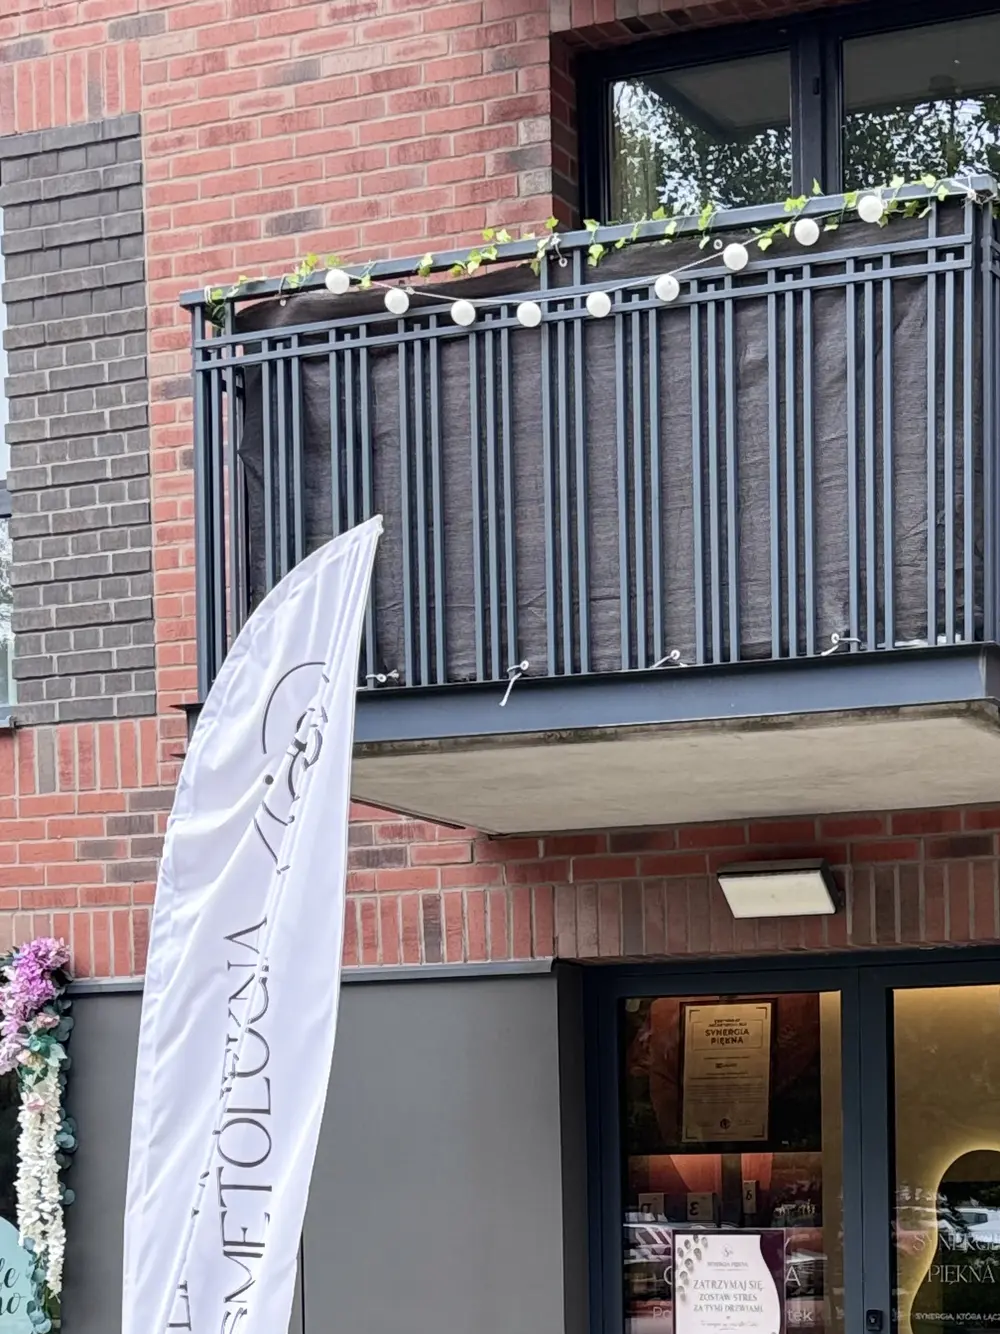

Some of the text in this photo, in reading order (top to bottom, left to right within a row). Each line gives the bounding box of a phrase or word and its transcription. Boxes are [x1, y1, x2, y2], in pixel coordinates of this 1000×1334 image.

[705, 1028, 749, 1037] SYNERGIA
[927, 1264, 996, 1285] PIĘKNA
[693, 1280, 746, 1291] ZATRZYMAJ
[699, 1293, 757, 1301] ZOSTAW STRES
